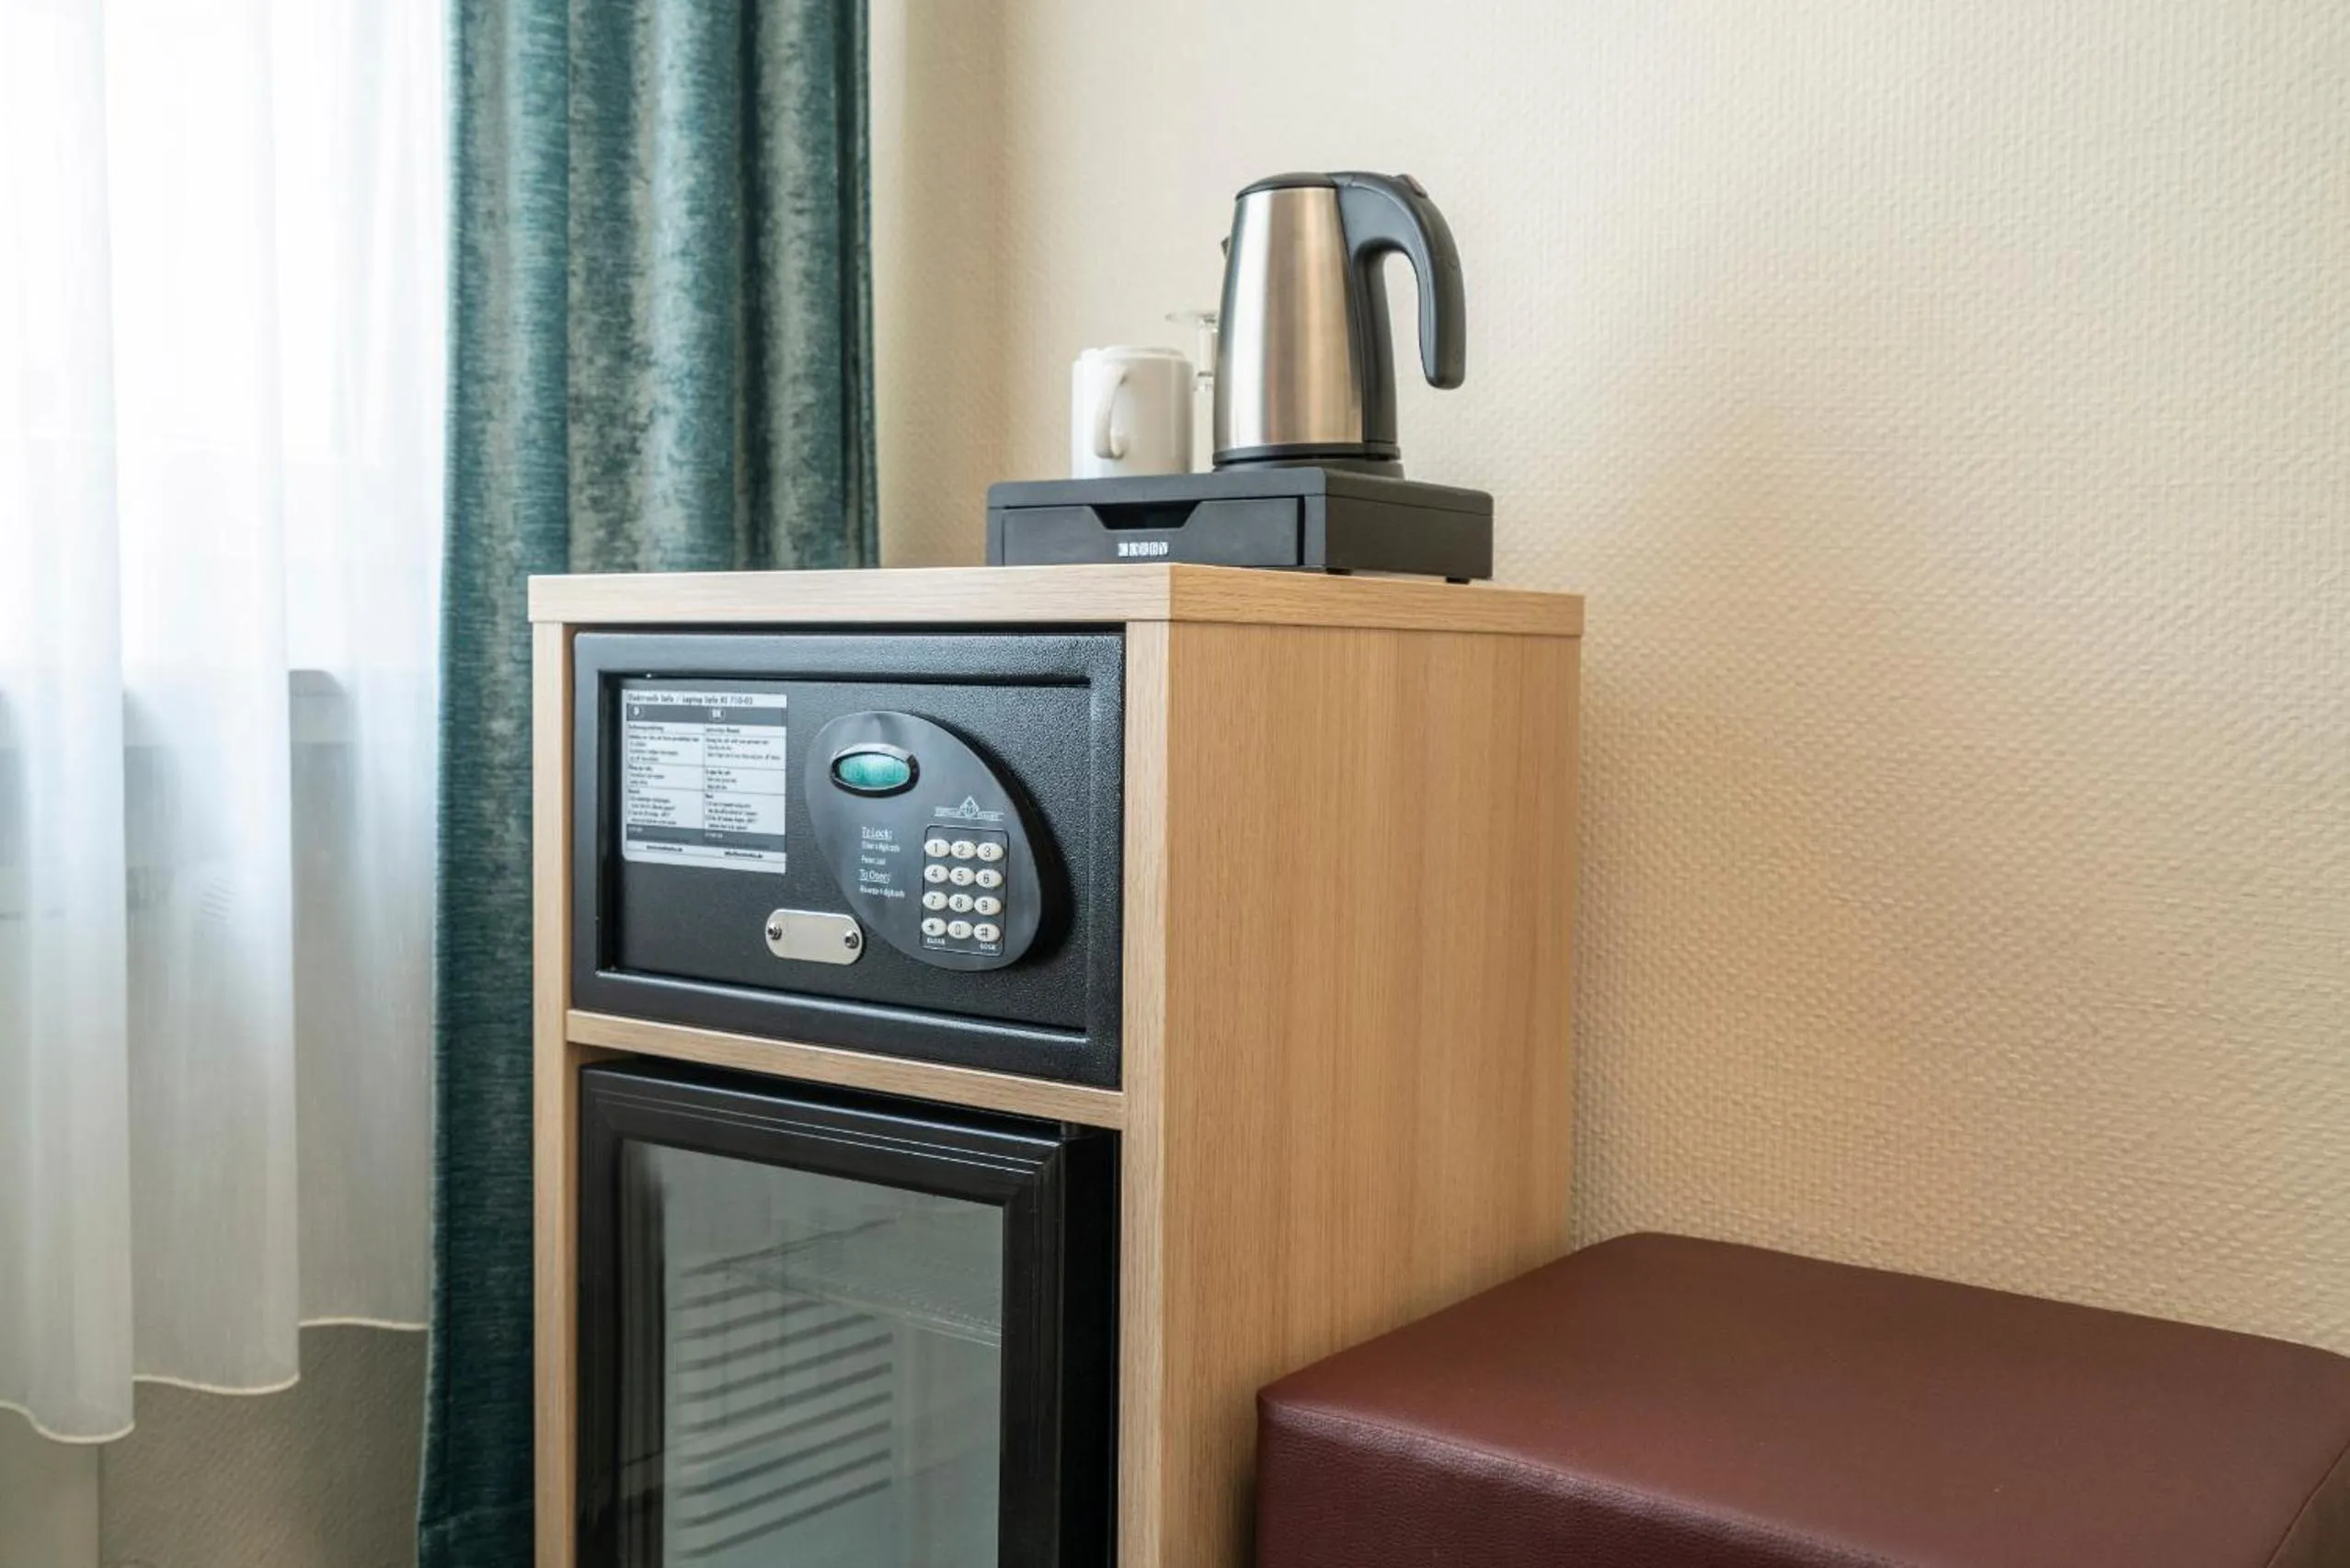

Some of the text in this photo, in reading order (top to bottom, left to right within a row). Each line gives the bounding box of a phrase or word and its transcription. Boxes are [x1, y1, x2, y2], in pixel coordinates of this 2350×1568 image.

[957, 842, 965, 855] 2
[983, 845, 991, 858] 3
[957, 870, 964, 882] 5
[983, 873, 990, 884] 6
[956, 897, 963, 909] 8
